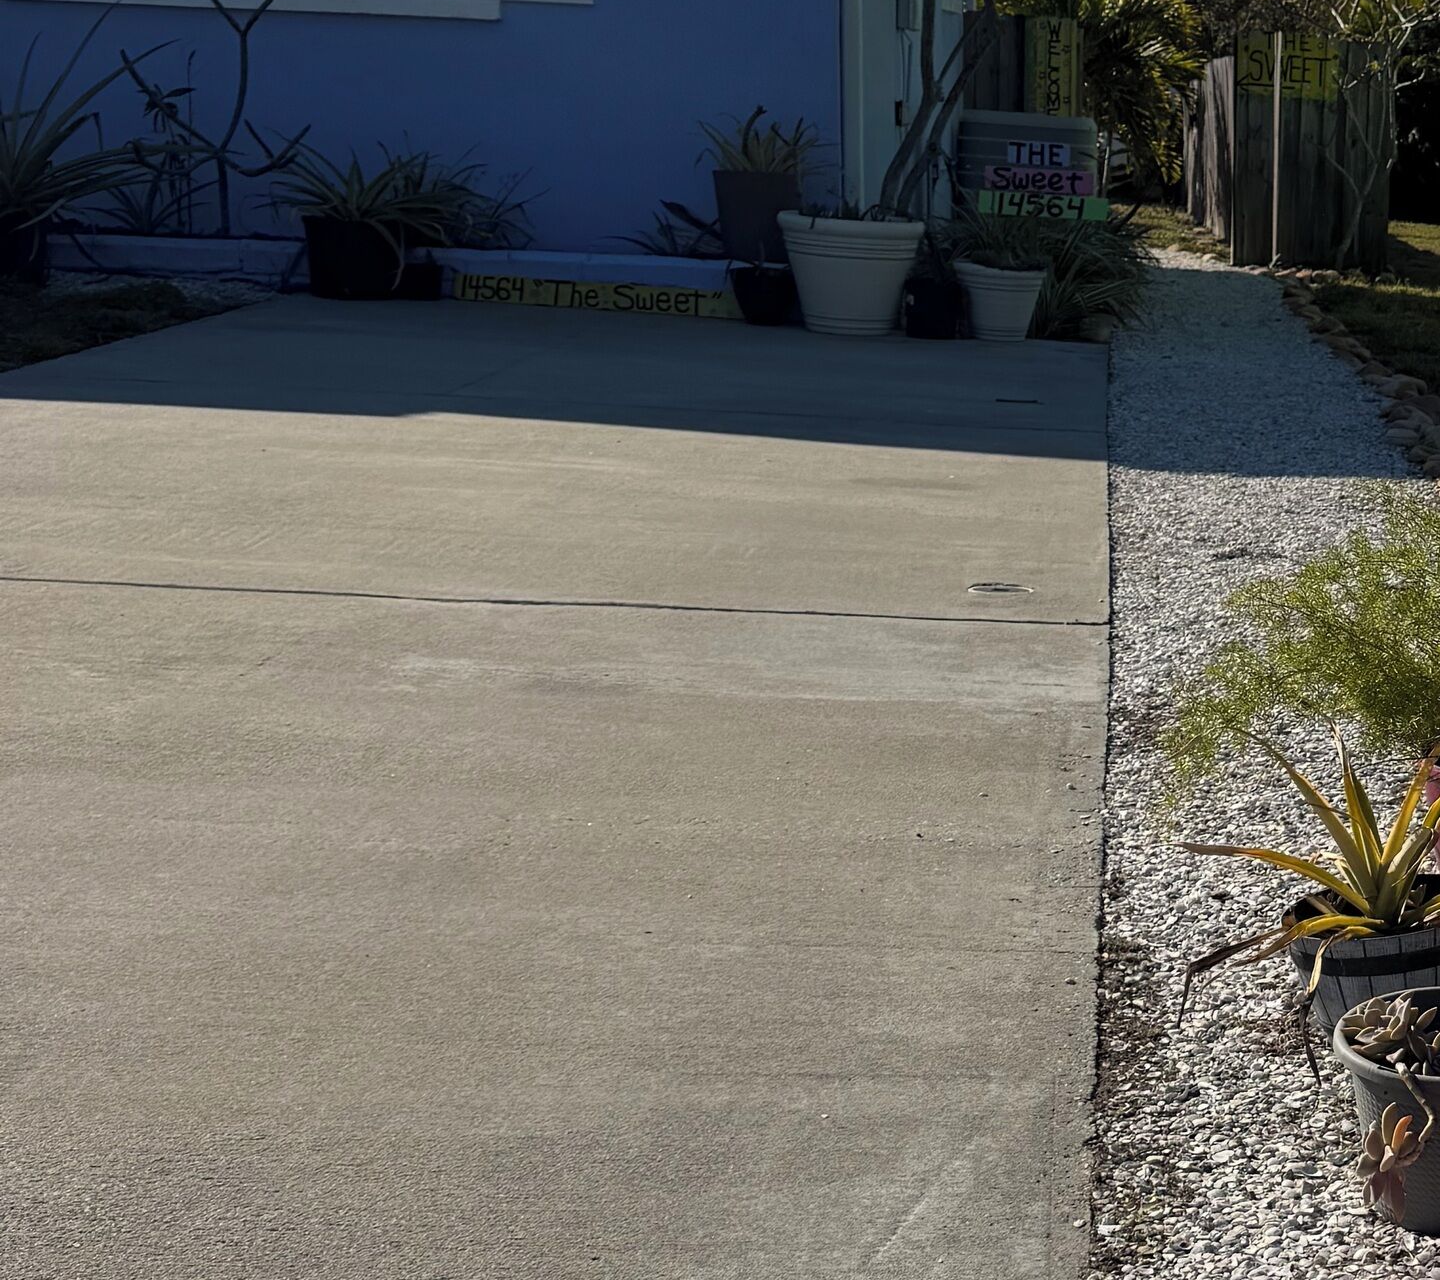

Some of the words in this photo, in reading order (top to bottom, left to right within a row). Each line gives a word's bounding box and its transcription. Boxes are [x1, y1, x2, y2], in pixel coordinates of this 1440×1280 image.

[1264, 30, 1312, 53] THE
[1249, 50, 1332, 86] SWEET
[1008, 141, 1064, 167] THE
[991, 167, 1084, 195] Sweet
[997, 192, 1085, 220] 14564
[460, 274, 525, 302] 14564
